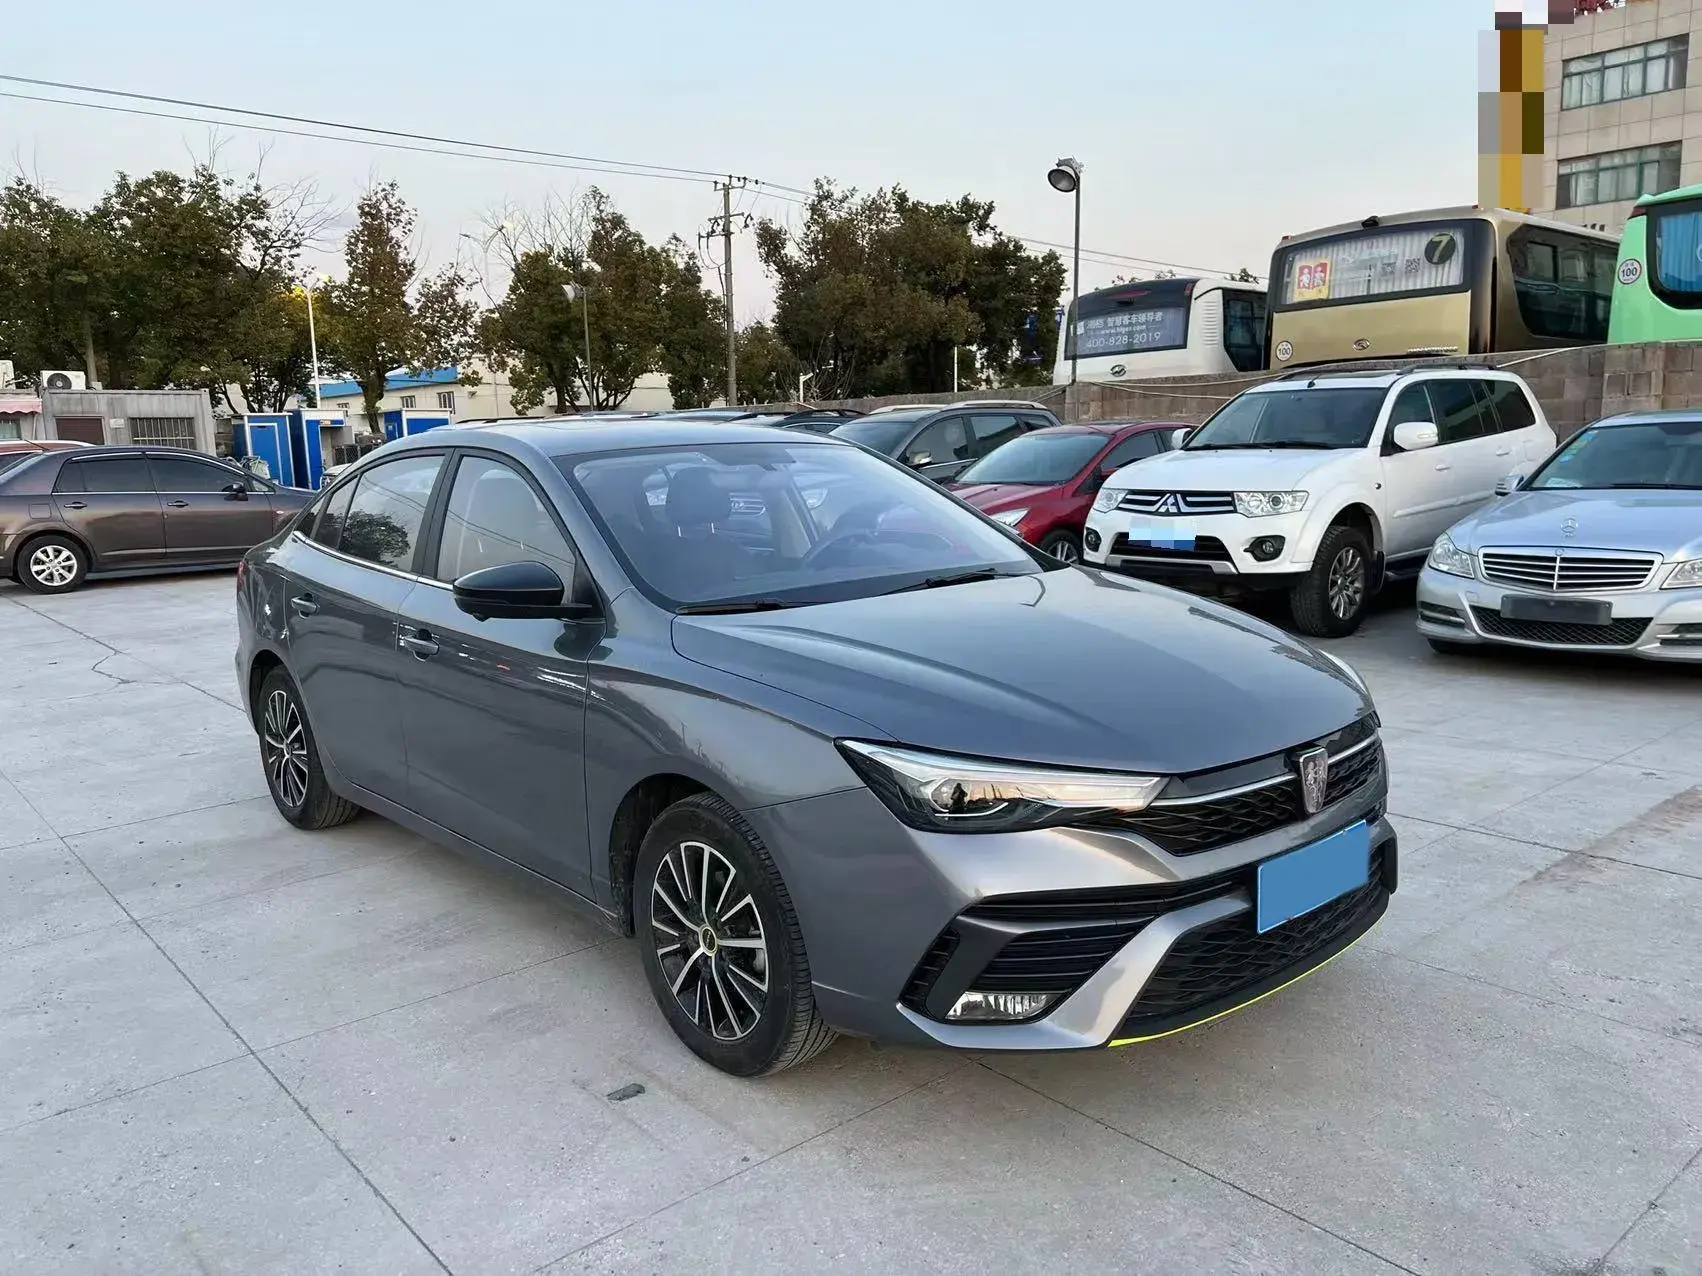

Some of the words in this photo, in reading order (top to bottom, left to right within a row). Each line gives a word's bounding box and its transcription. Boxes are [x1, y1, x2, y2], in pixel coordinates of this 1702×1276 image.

[1431, 235, 1451, 263] 7
[1621, 267, 1638, 278] 100
[1087, 332, 1161, 348] 400-828-2019
[1278, 347, 1291, 356] 100
